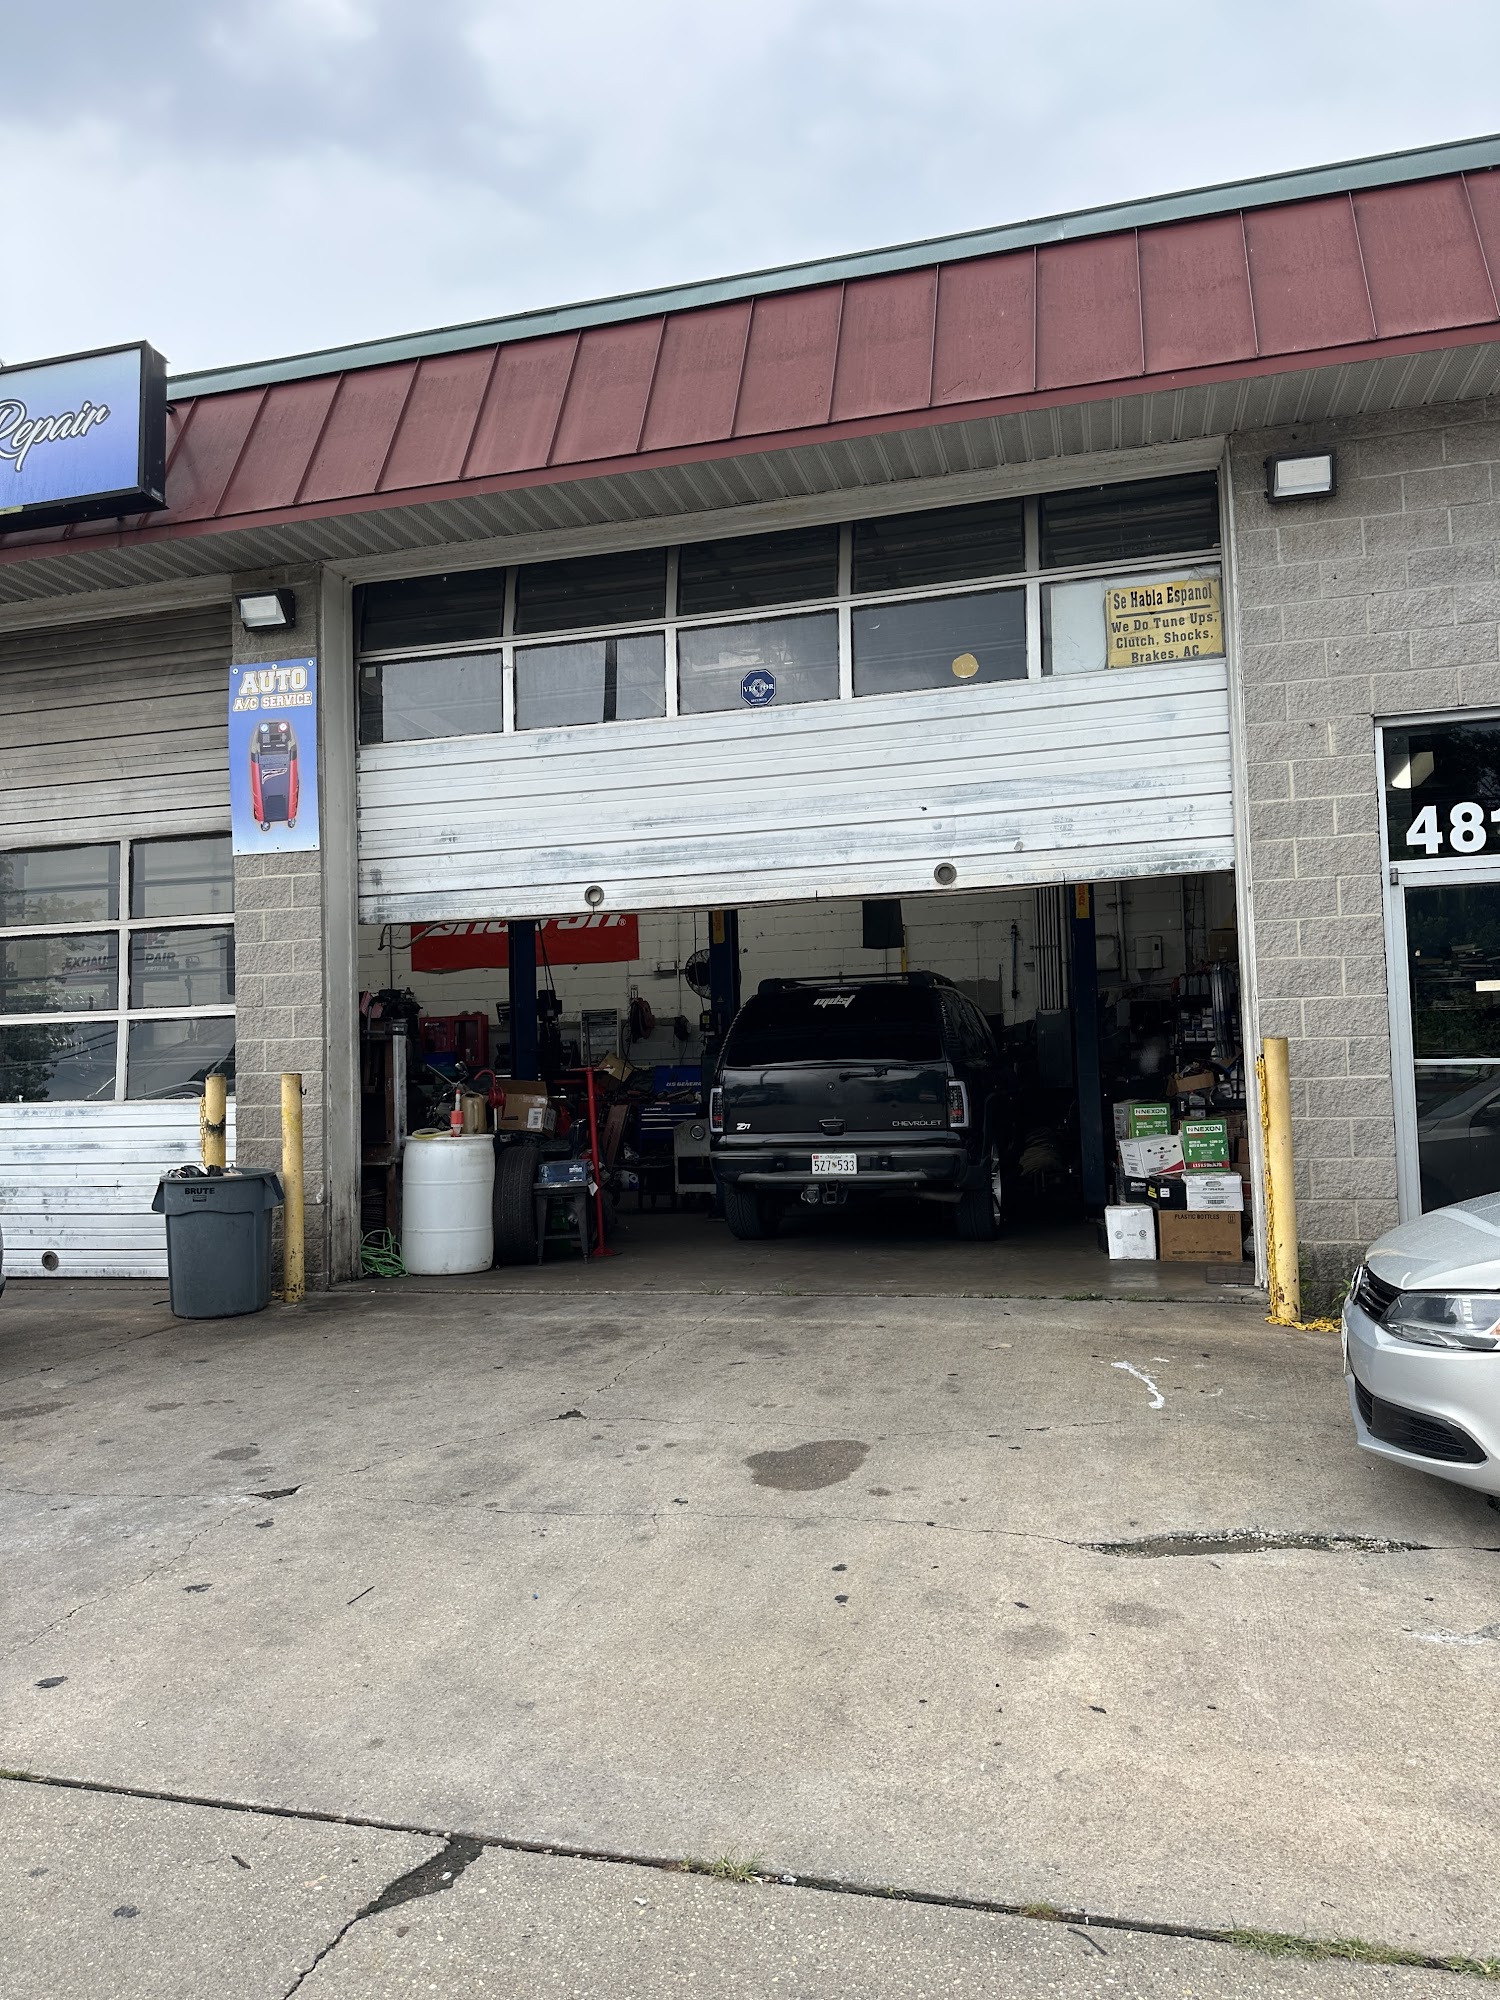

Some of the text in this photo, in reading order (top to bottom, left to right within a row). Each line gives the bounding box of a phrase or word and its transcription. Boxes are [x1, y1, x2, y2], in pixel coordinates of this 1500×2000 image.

[0, 399, 111, 473] Repair
[1113, 582, 1213, 610] Se Habla Espanol
[1111, 622, 1129, 633] We
[1133, 619, 1149, 631] Do
[1153, 616, 1185, 628] Tune
[1116, 634, 1159, 649] Clutch,
[1183, 644, 1200, 657] AC
[240, 667, 307, 696] AUTO
[233, 692, 312, 712] A/C SERVICE
[892, 1119, 943, 1127] CHEVROLET
[184, 1187, 216, 1195] BRUTE
